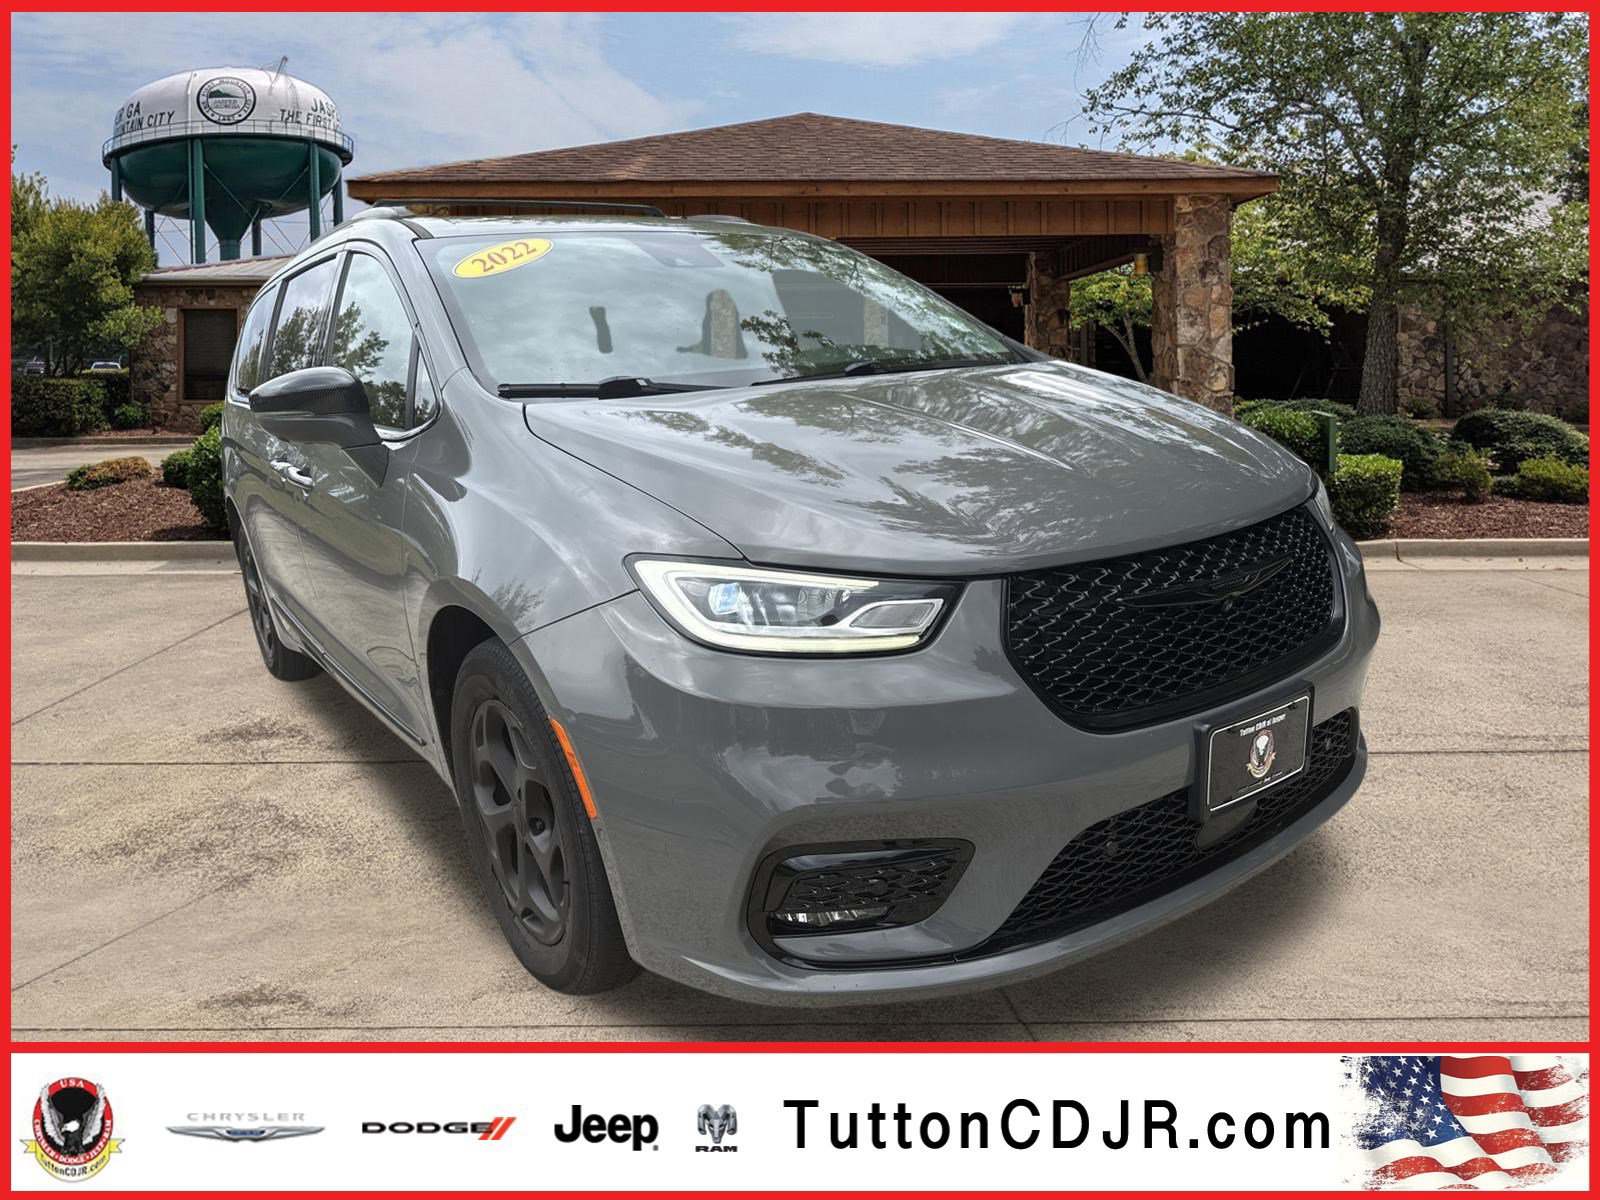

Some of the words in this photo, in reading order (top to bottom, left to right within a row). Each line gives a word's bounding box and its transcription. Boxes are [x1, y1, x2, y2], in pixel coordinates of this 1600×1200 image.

[126, 101, 141, 119] GA
[147, 110, 175, 127] CITY
[280, 109, 302, 124] THE
[471, 242, 537, 272] 2022
